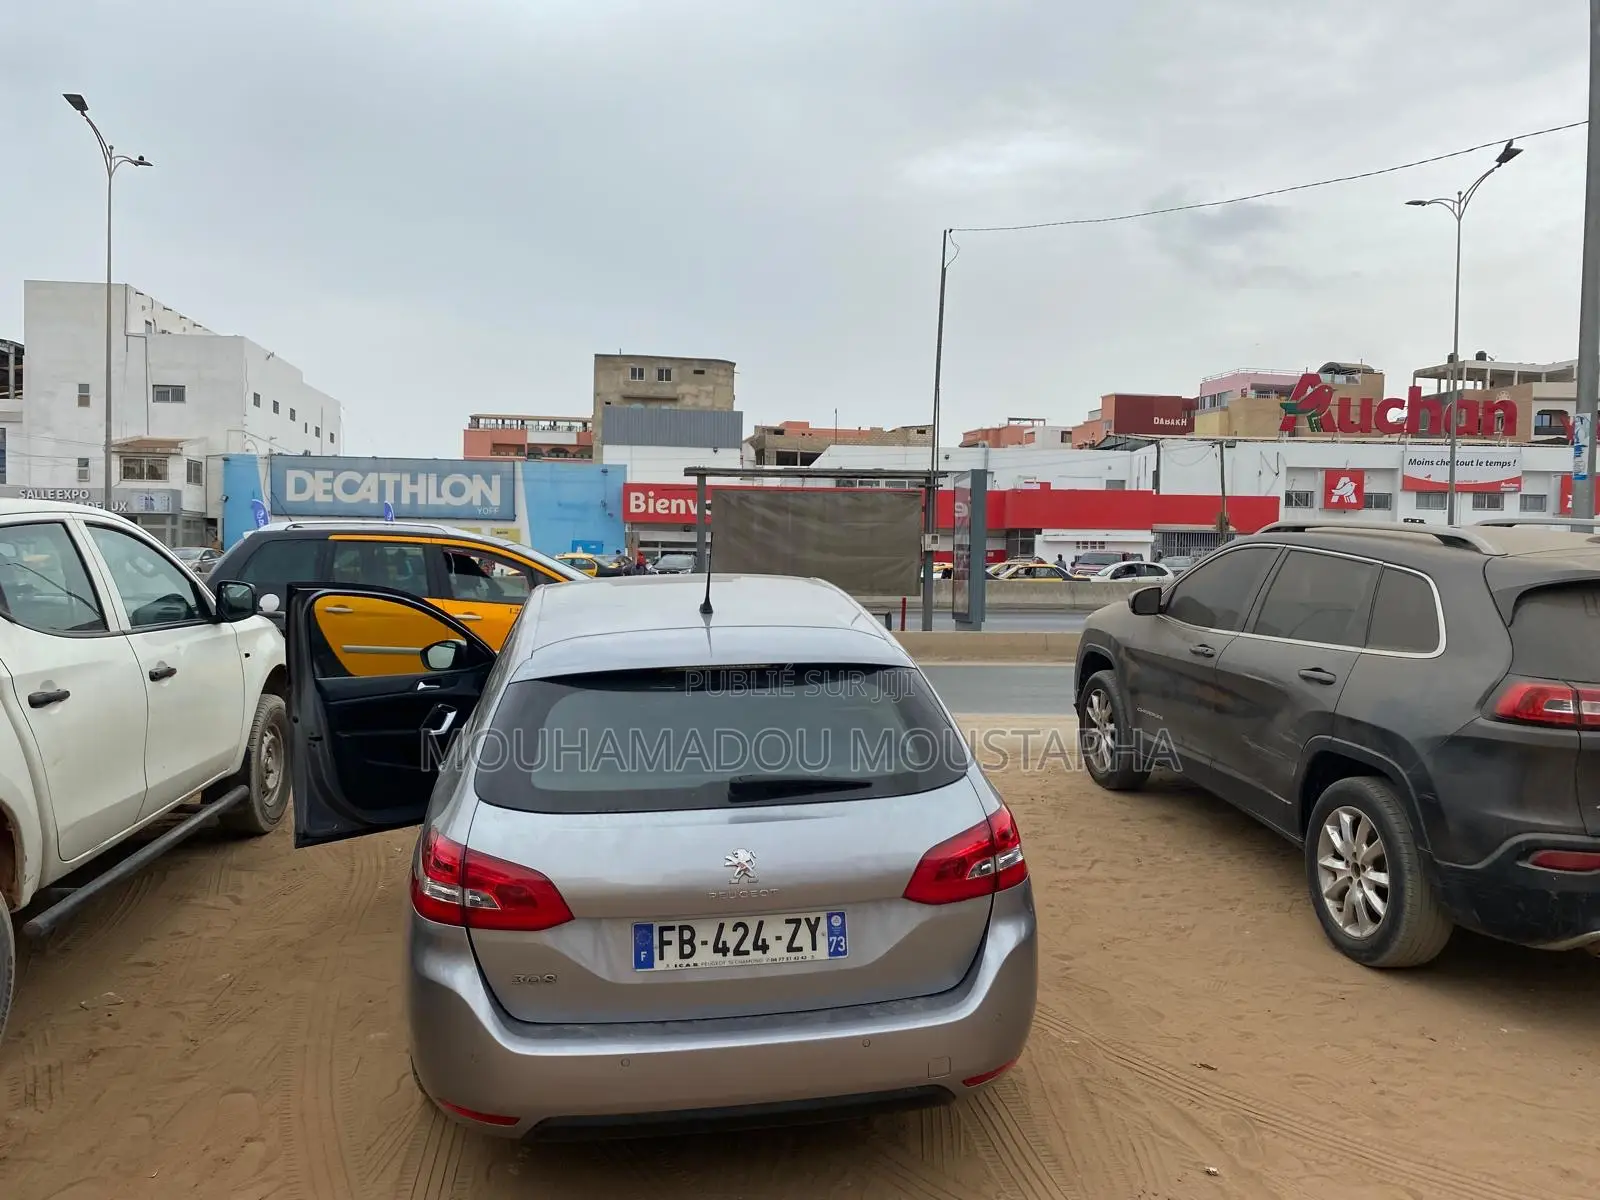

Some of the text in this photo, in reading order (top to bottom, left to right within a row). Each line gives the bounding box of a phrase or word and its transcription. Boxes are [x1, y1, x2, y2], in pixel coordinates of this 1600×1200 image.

[1279, 373, 1518, 437] Auchan
[1408, 458, 1434, 466] Moins
[1435, 458, 1451, 466] che
[1456, 459, 1474, 467] tout
[1476, 459, 1484, 467] le
[1485, 459, 1511, 468] temps
[286, 469, 501, 506] DECATHLON
[19, 489, 90, 500] SALLE EXPO
[477, 506, 500, 515] YOFF
[708, 887, 780, 899] PEUGEOT
[658, 916, 822, 961] FB-424-ZY
[829, 936, 846, 953] 73
[640, 951, 648, 962] F
[511, 973, 558, 985] 308
